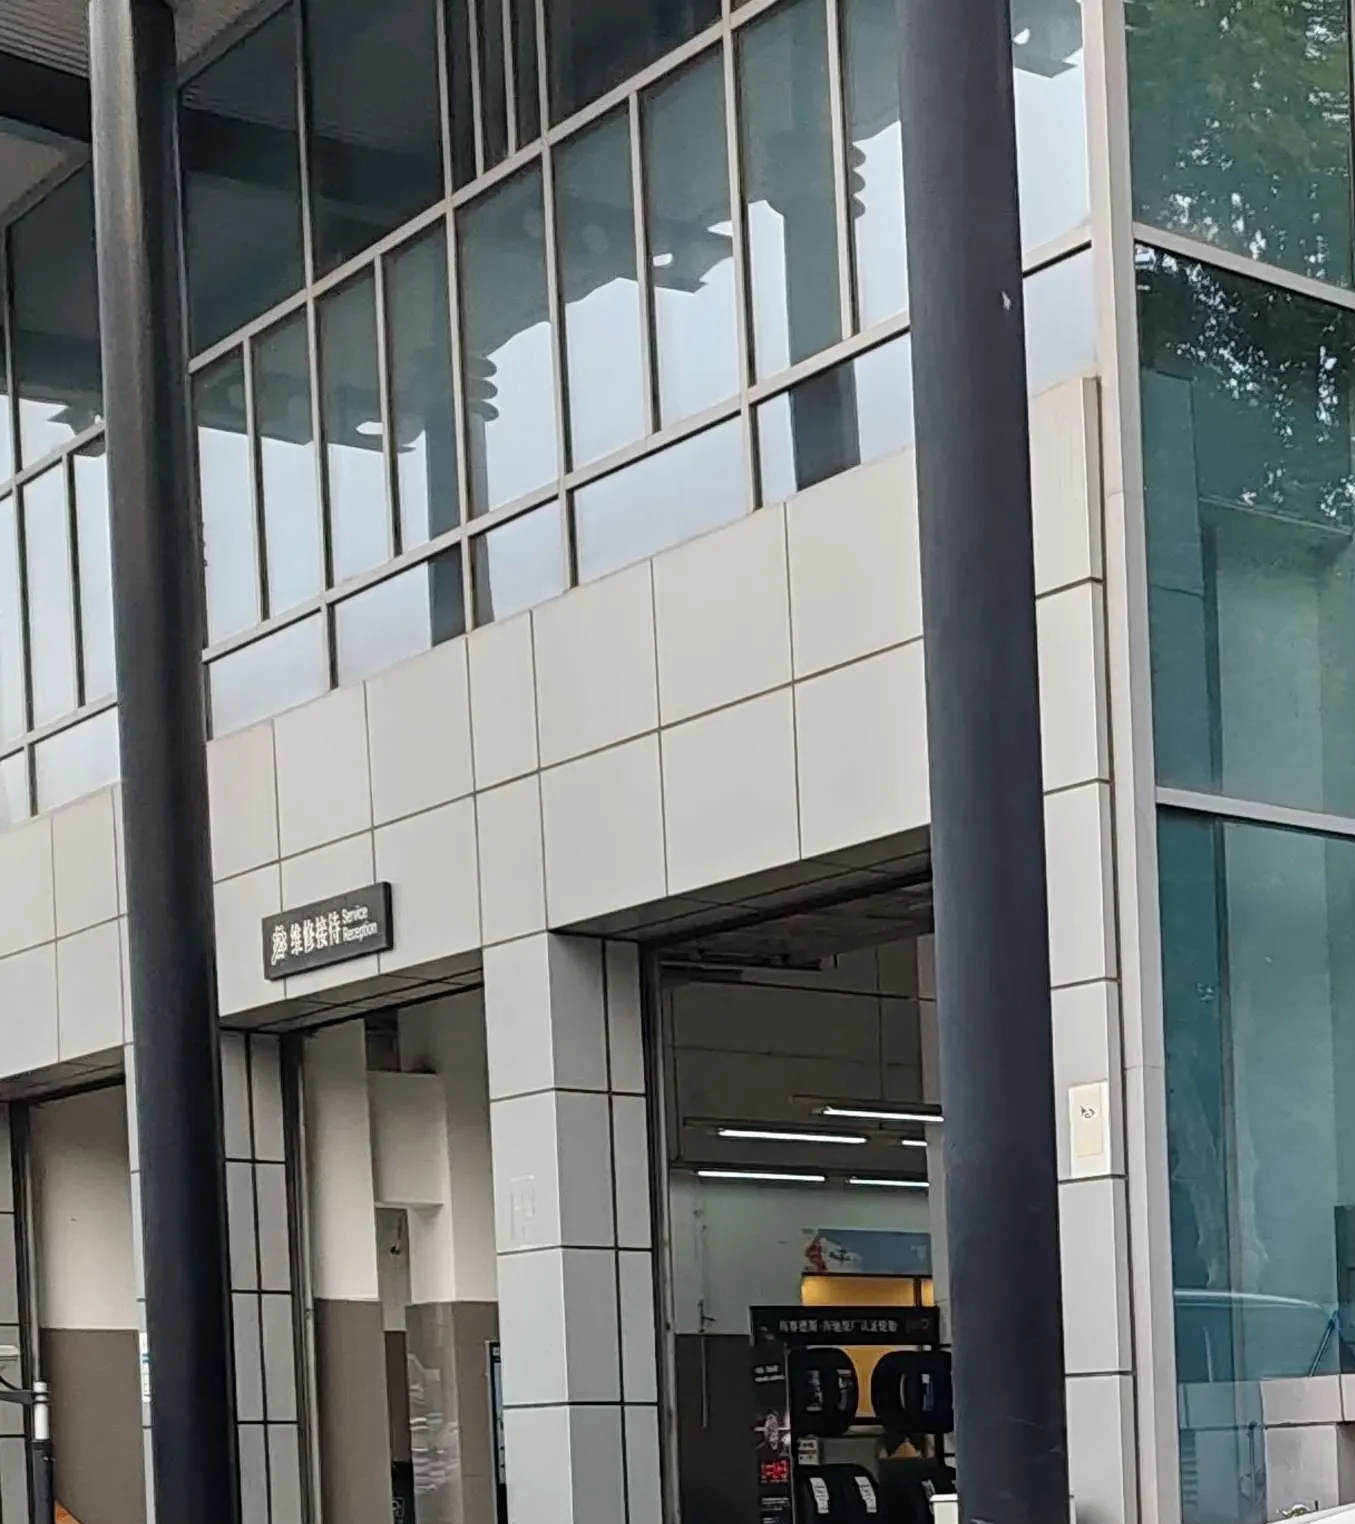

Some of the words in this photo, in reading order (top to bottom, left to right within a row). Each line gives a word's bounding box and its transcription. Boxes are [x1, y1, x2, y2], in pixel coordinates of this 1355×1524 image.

[342, 905, 368, 923] Service
[290, 911, 340, 955] 维修接待
[342, 921, 377, 942] Reception
